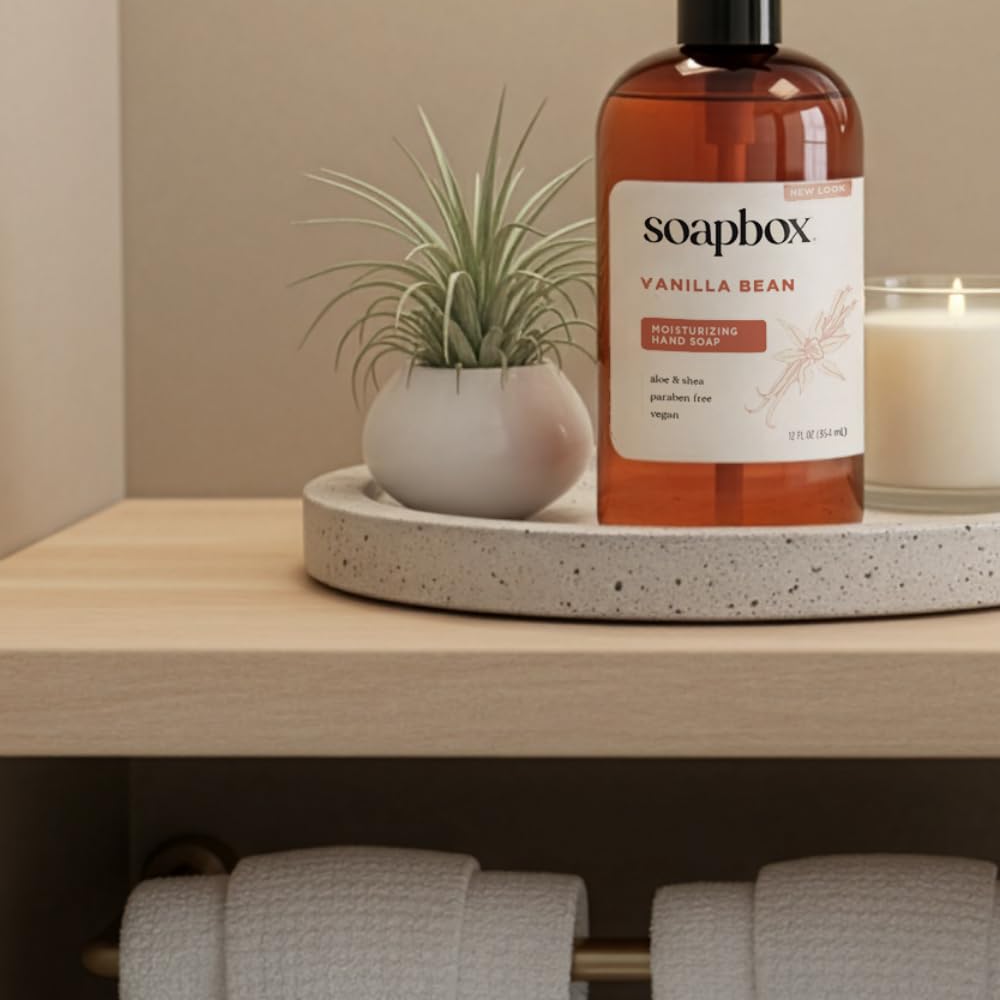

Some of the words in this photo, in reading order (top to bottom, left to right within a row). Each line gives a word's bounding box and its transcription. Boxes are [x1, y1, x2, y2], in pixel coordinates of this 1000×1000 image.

[789, 187, 815, 197] NEW
[817, 184, 846, 195] LOOK
[643, 208, 811, 257] soapbox
[640, 277, 731, 293] VANILLA
[739, 278, 796, 293] BEAN
[651, 324, 739, 337] MOISTURIZING
[651, 335, 686, 346] HAND
[689, 336, 721, 347] SOAP
[650, 374, 670, 384] aloe
[672, 375, 680, 384] &
[681, 376, 704, 385] shea
[650, 393, 690, 403] paraben
[693, 393, 712, 403] free
[650, 411, 679, 420] vegan
[788, 431, 796, 441] 12
